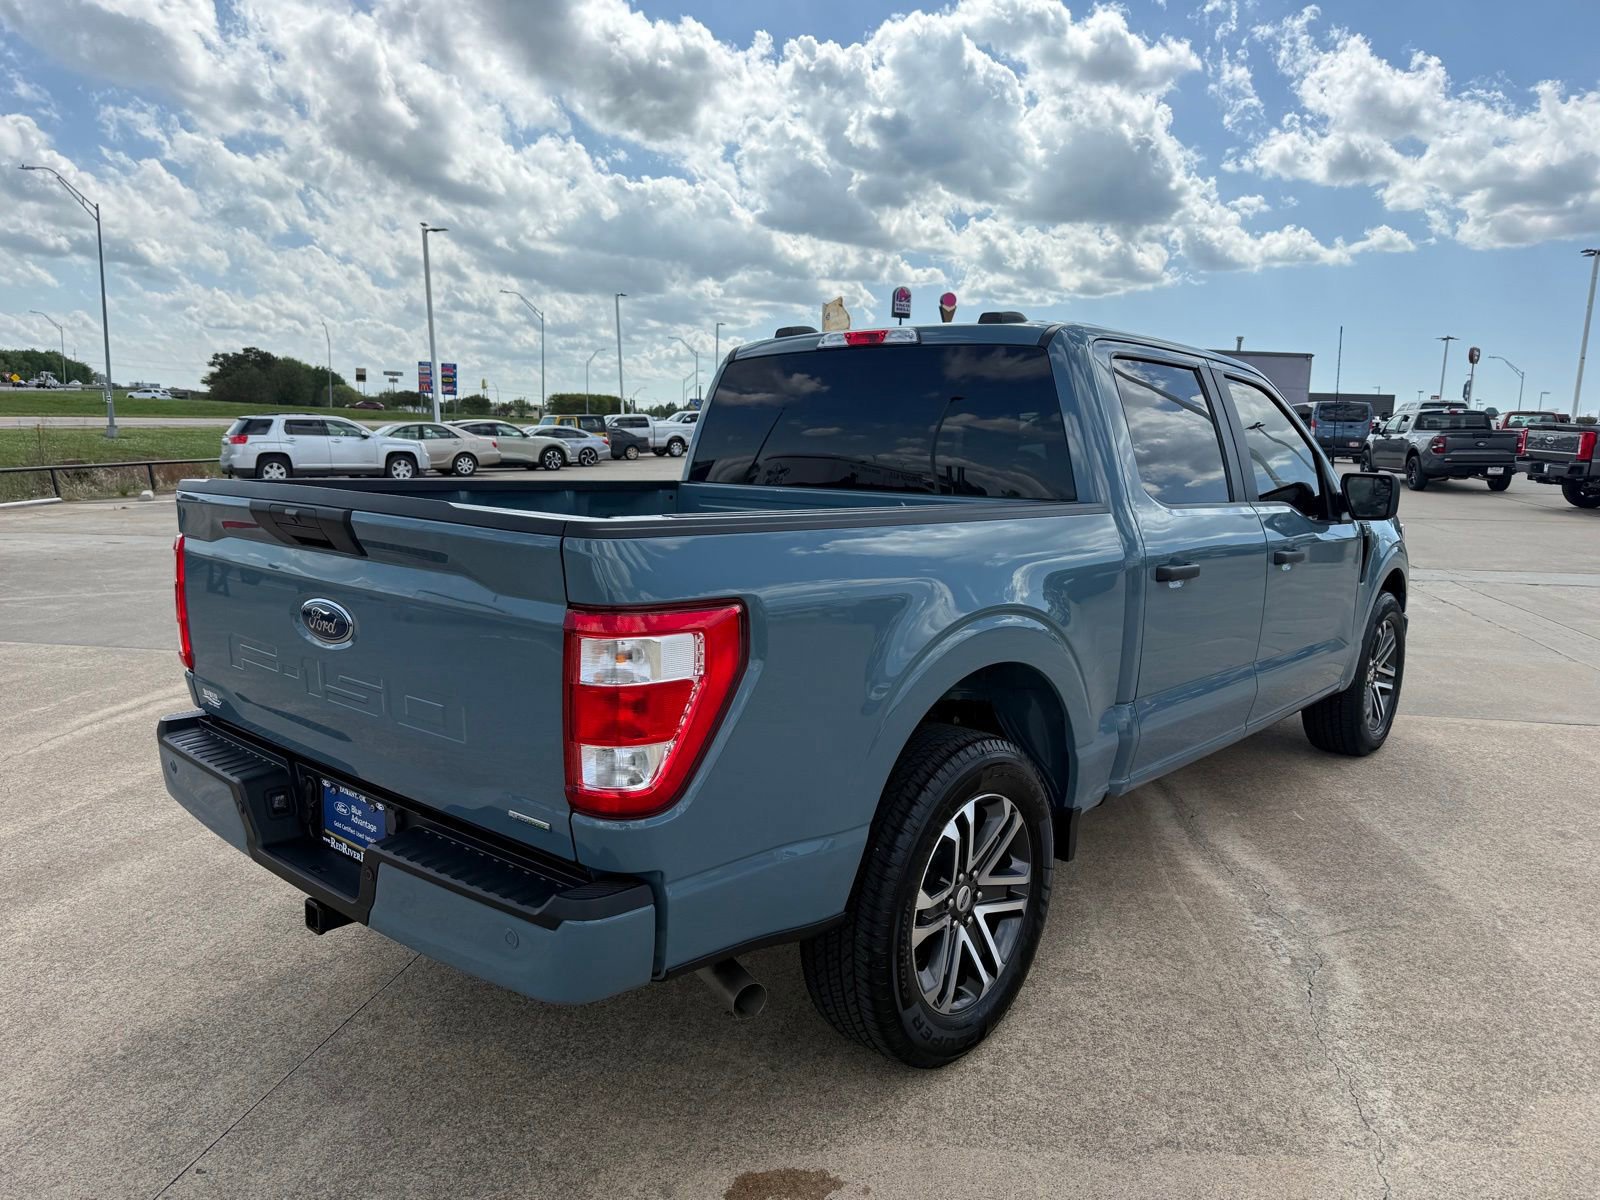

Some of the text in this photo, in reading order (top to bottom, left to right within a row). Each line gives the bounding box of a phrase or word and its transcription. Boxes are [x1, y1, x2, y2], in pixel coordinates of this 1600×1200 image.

[309, 606, 338, 634] Ford
[228, 633, 467, 744] F-150
[351, 804, 363, 817] Blue
[333, 820, 342, 829] Gold
[341, 823, 356, 835] Certified
[355, 830, 365, 839] Used
[351, 814, 377, 833] Advantage
